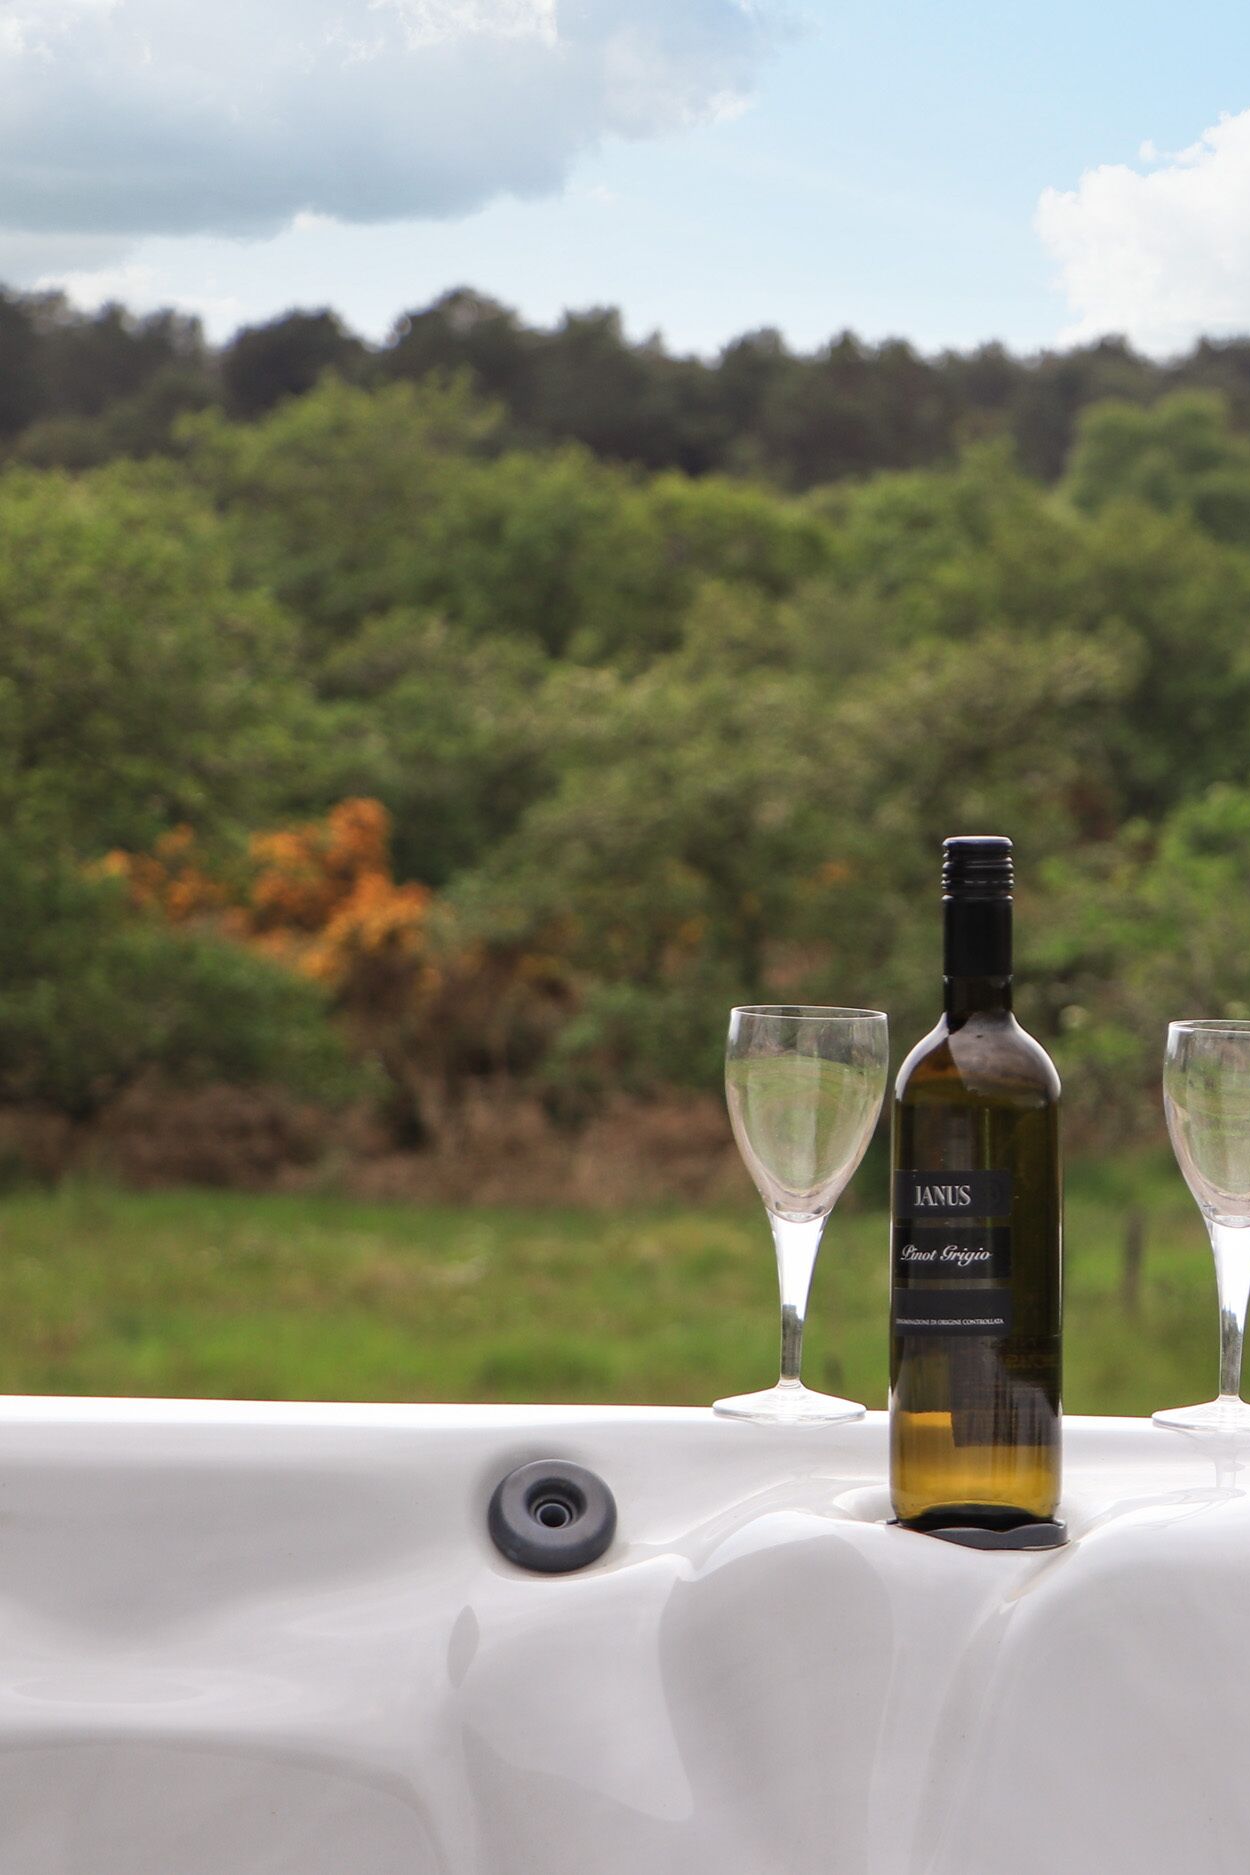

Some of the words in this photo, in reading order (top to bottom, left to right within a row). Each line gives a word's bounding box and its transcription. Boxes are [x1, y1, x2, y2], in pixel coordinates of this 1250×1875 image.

[914, 1185, 971, 1206] JANUS
[901, 1244, 936, 1261] Pinot
[940, 1245, 991, 1267] Grigio
